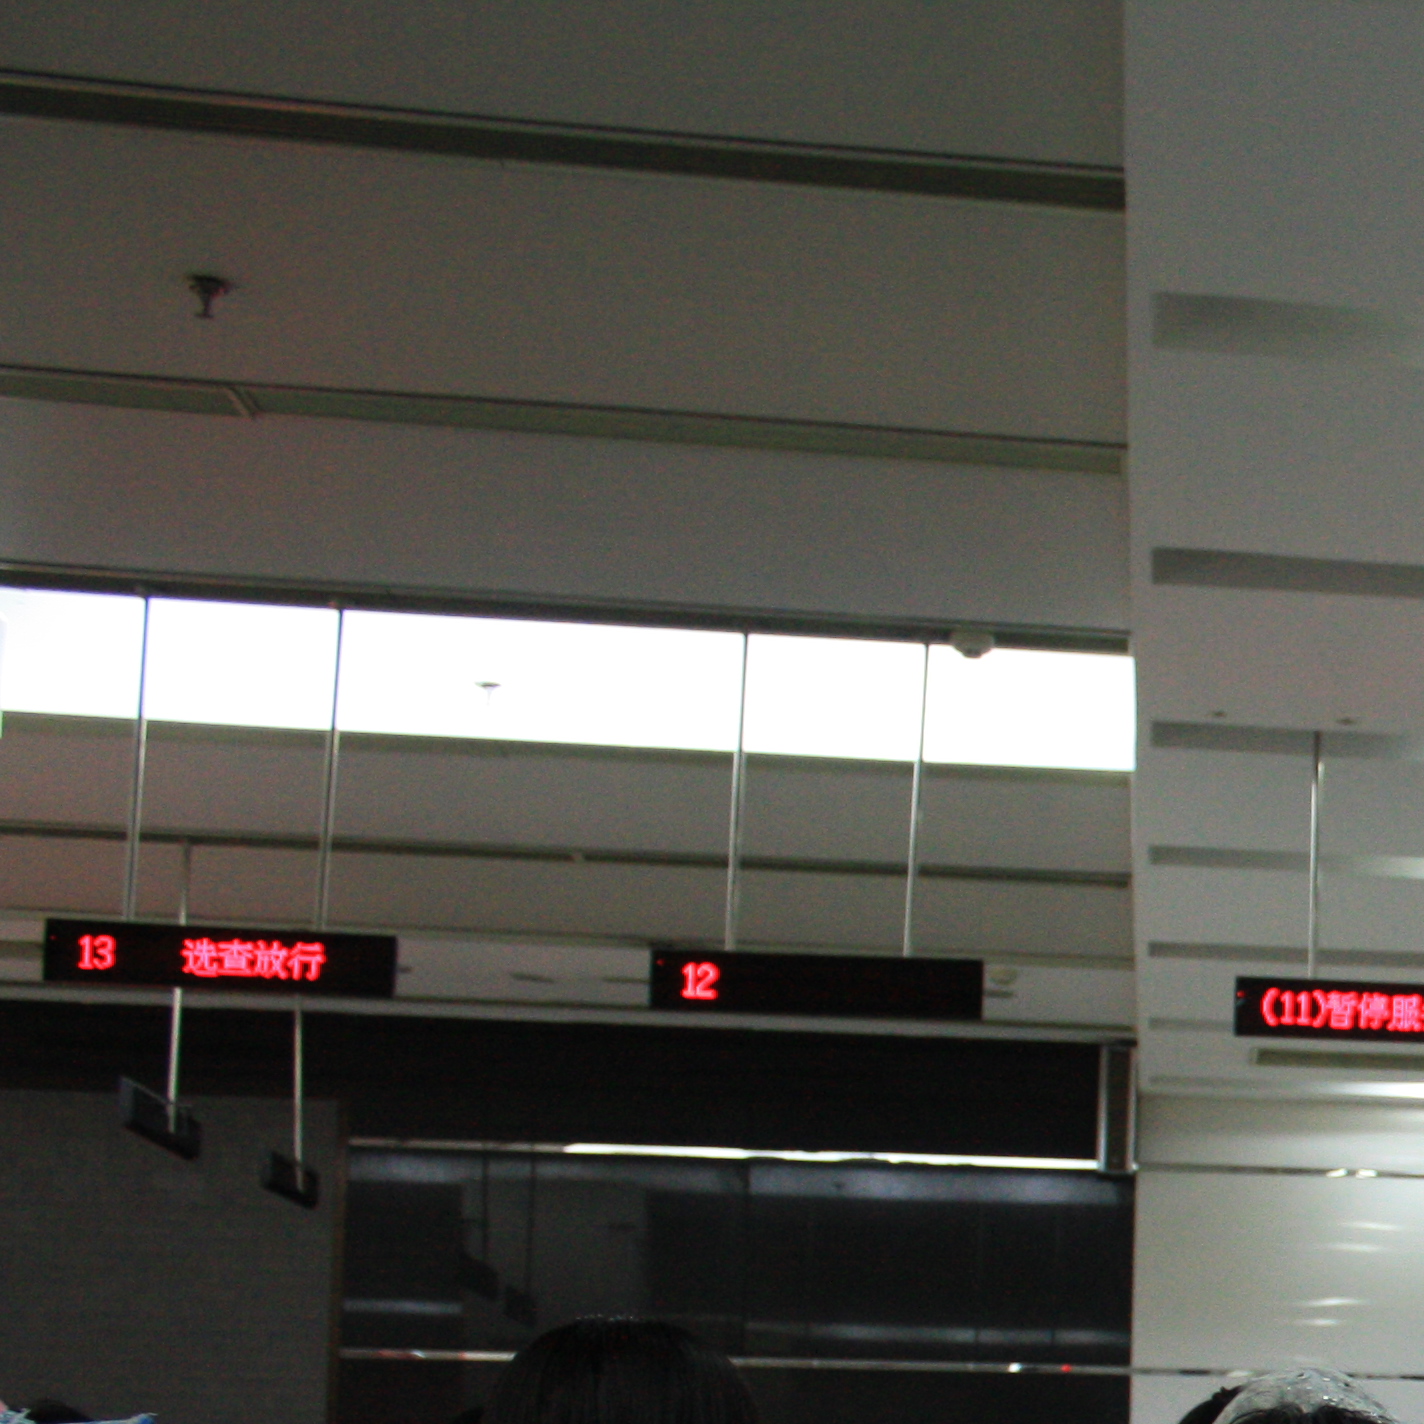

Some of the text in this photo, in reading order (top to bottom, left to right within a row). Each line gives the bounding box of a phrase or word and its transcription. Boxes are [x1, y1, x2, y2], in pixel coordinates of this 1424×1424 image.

[77, 934, 328, 982] 13 选查放行
[680, 961, 720, 1001] 12
